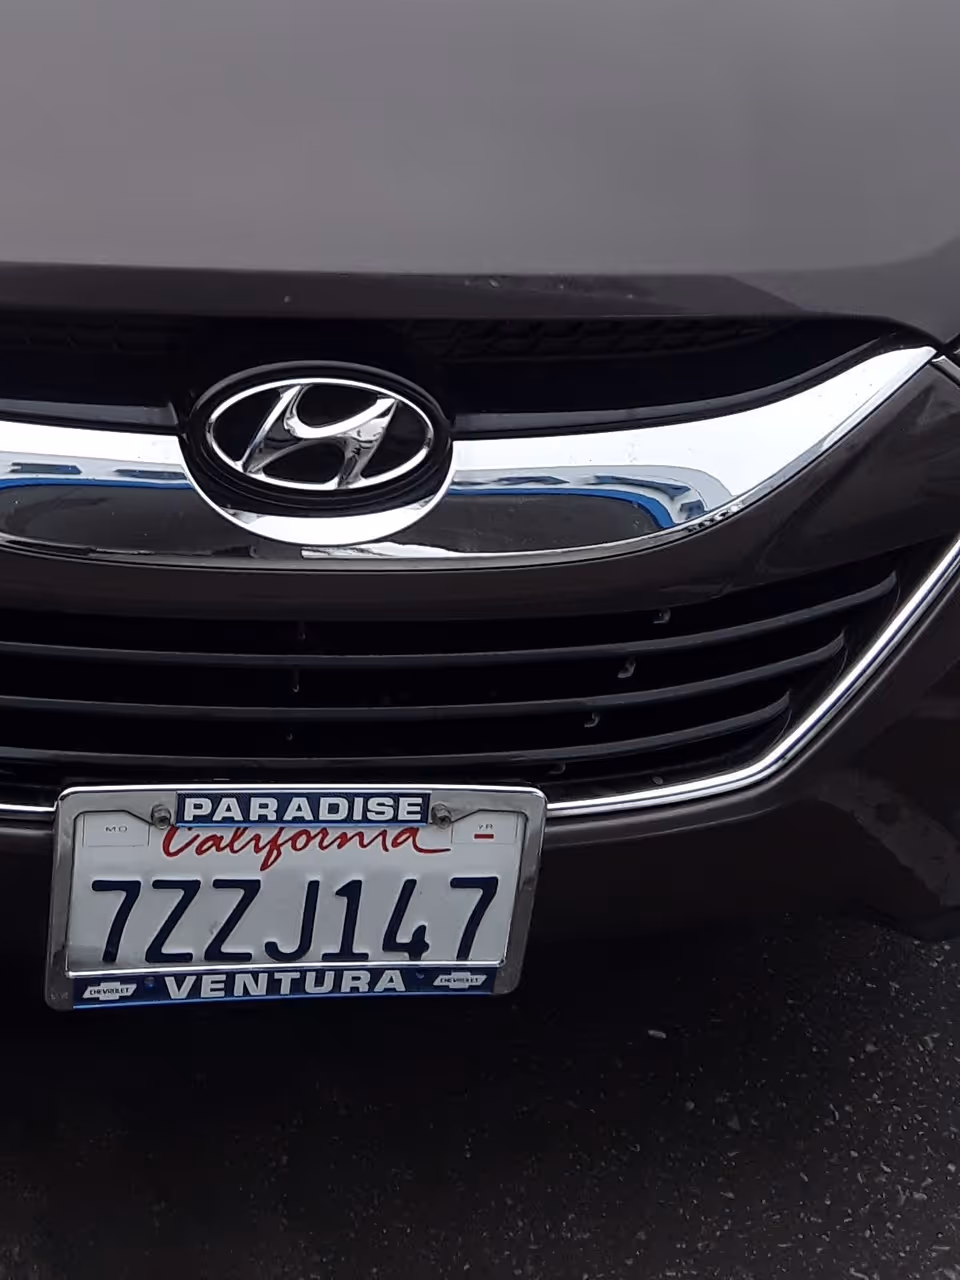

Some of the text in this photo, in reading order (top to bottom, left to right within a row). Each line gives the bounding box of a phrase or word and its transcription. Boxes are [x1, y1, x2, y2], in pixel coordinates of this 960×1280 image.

[183, 797, 423, 821] PARADISE
[162, 826, 451, 871] California
[91, 876, 499, 963] 7ZZJ147
[89, 987, 130, 996] CHEVROLET
[163, 970, 407, 999] VENTURA
